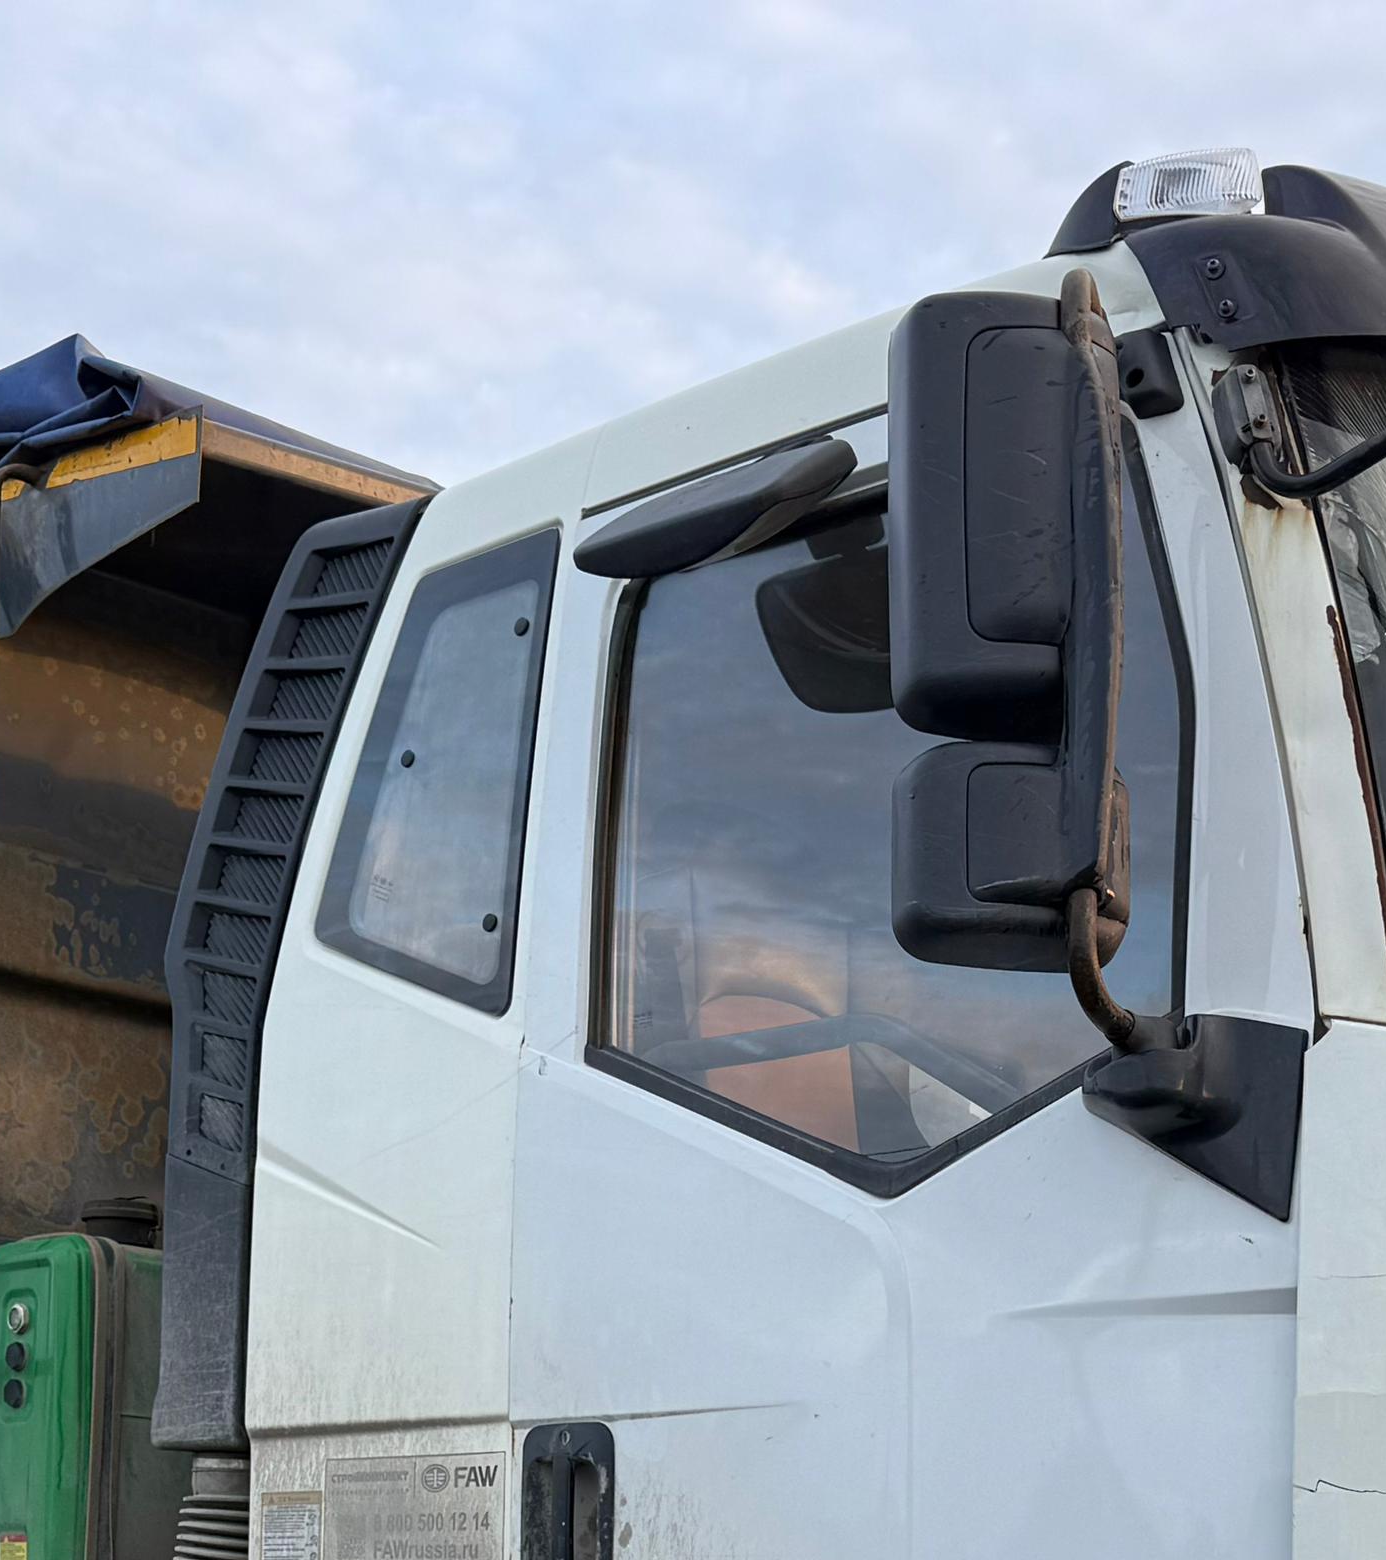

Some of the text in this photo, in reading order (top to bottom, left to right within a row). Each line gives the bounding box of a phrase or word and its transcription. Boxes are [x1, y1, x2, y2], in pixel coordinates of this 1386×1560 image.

[454, 1464, 499, 1488] FAW
[418, 1512, 444, 1531] 500
[450, 1512, 467, 1531] 12
[472, 1511, 490, 1531] 14
[373, 1540, 479, 1560] FAWrussia.ru
